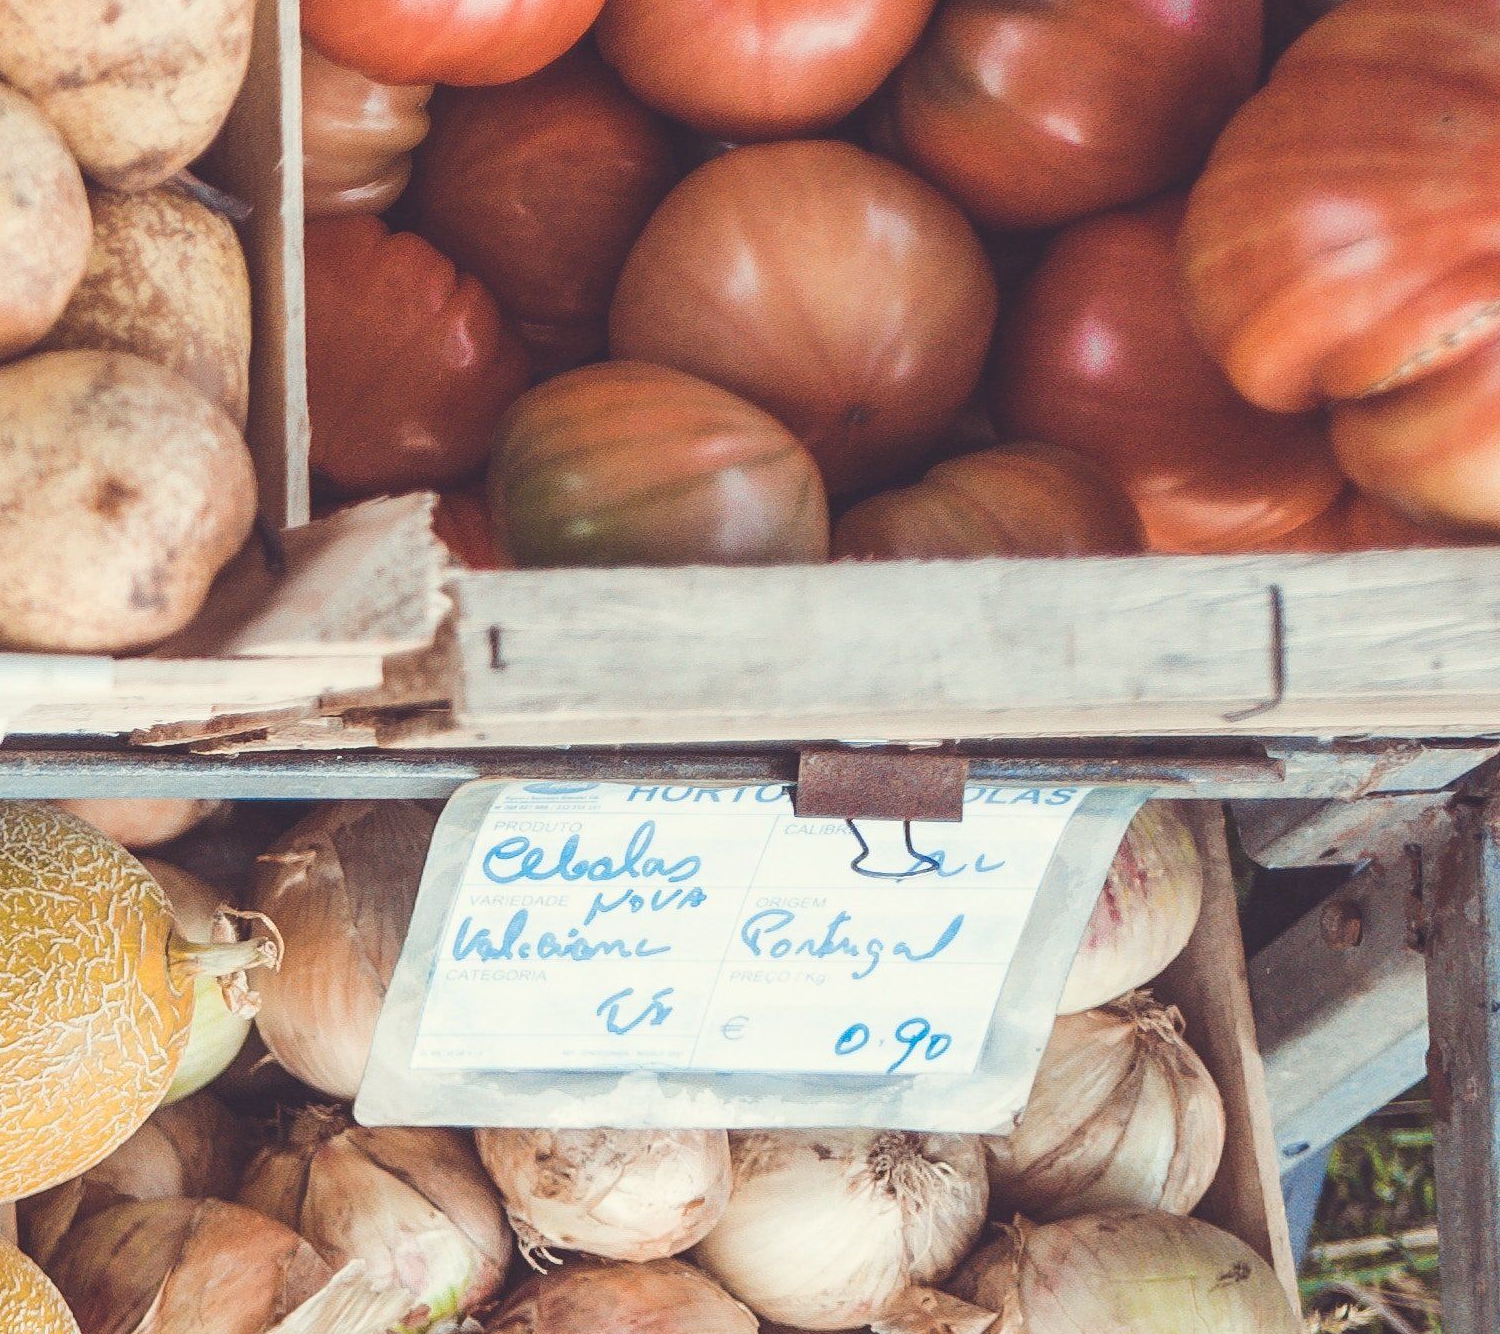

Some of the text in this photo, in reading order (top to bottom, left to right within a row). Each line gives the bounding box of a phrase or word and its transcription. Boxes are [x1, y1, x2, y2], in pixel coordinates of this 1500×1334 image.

[493, 821, 583, 833] PRODUTO
[784, 824, 851, 835] CALIBR
[469, 895, 570, 907] VARIEDADE
[755, 897, 827, 908] ORIGEM
[741, 908, 964, 980] Portugal
[446, 970, 547, 981] CATEGORIA
[729, 971, 791, 983] PREÇO
[805, 971, 827, 984] Kg
[720, 1016, 750, 1040] €
